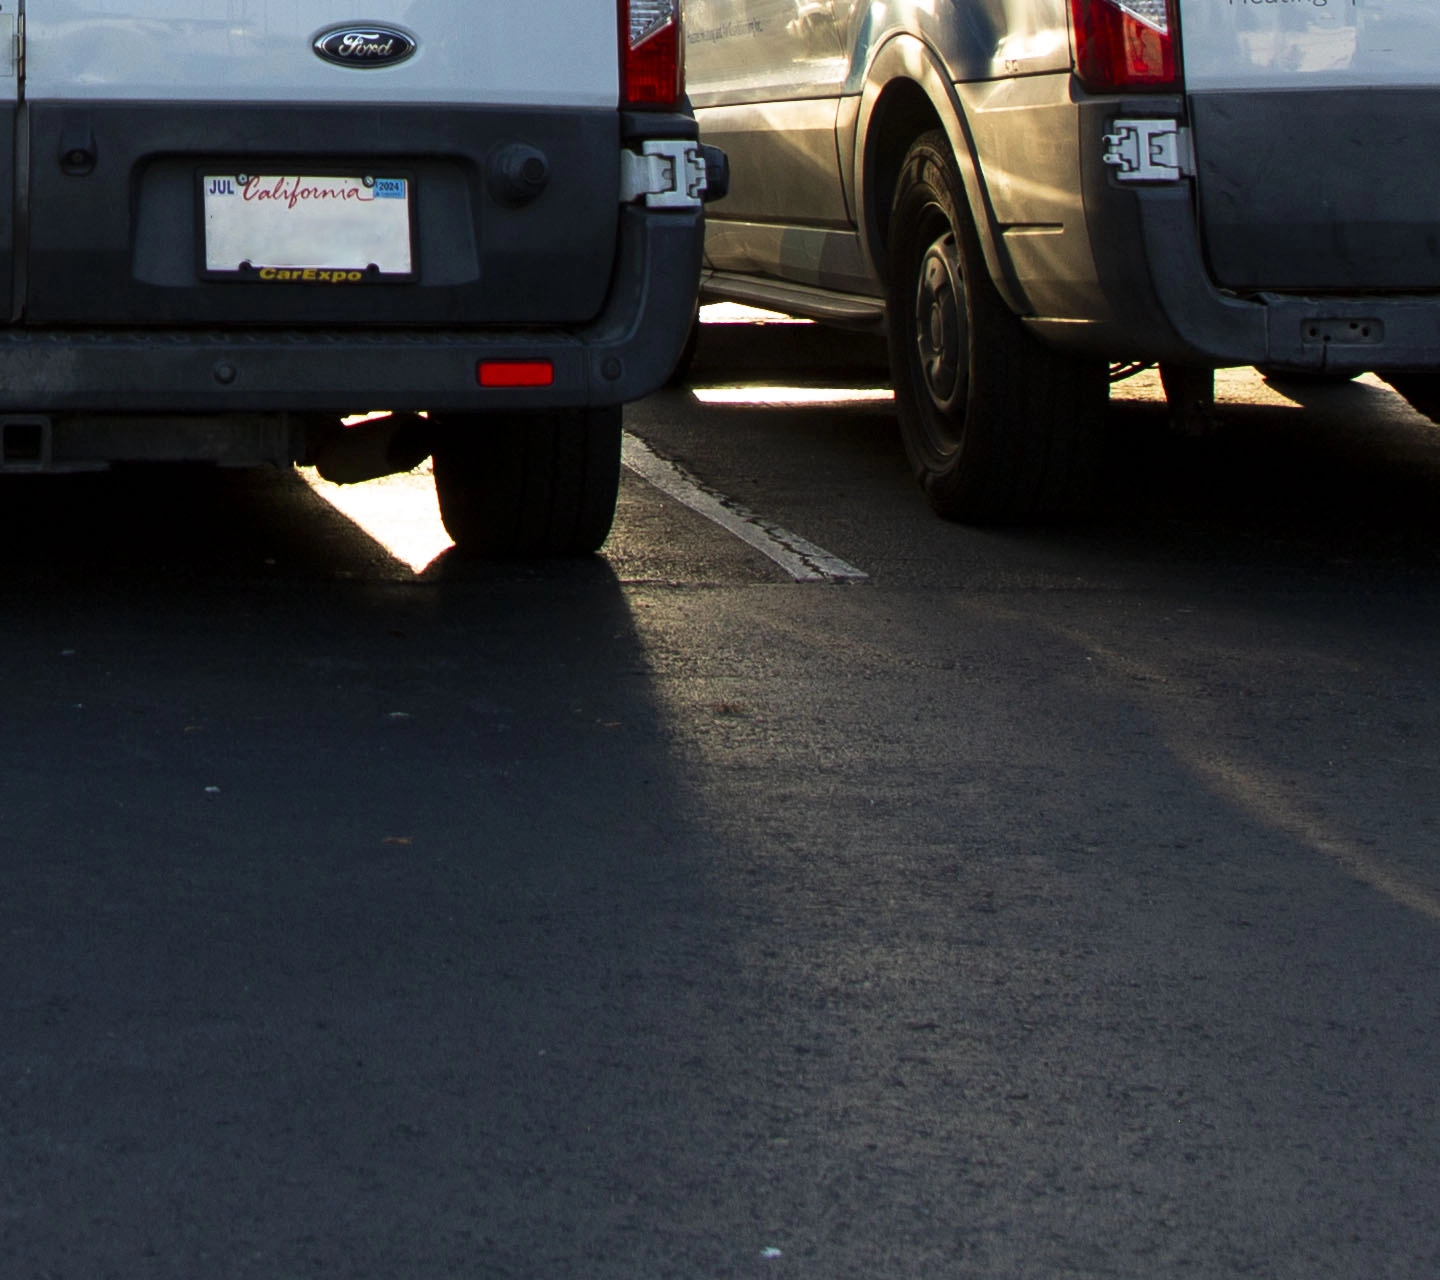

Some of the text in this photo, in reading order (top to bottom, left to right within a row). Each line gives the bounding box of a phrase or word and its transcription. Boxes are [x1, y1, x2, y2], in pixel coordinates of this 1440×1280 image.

[338, 32, 394, 58] Ford
[209, 179, 236, 195] JUL
[242, 175, 375, 209] California
[378, 181, 400, 191] 2024
[258, 267, 363, 284] CarExpo
